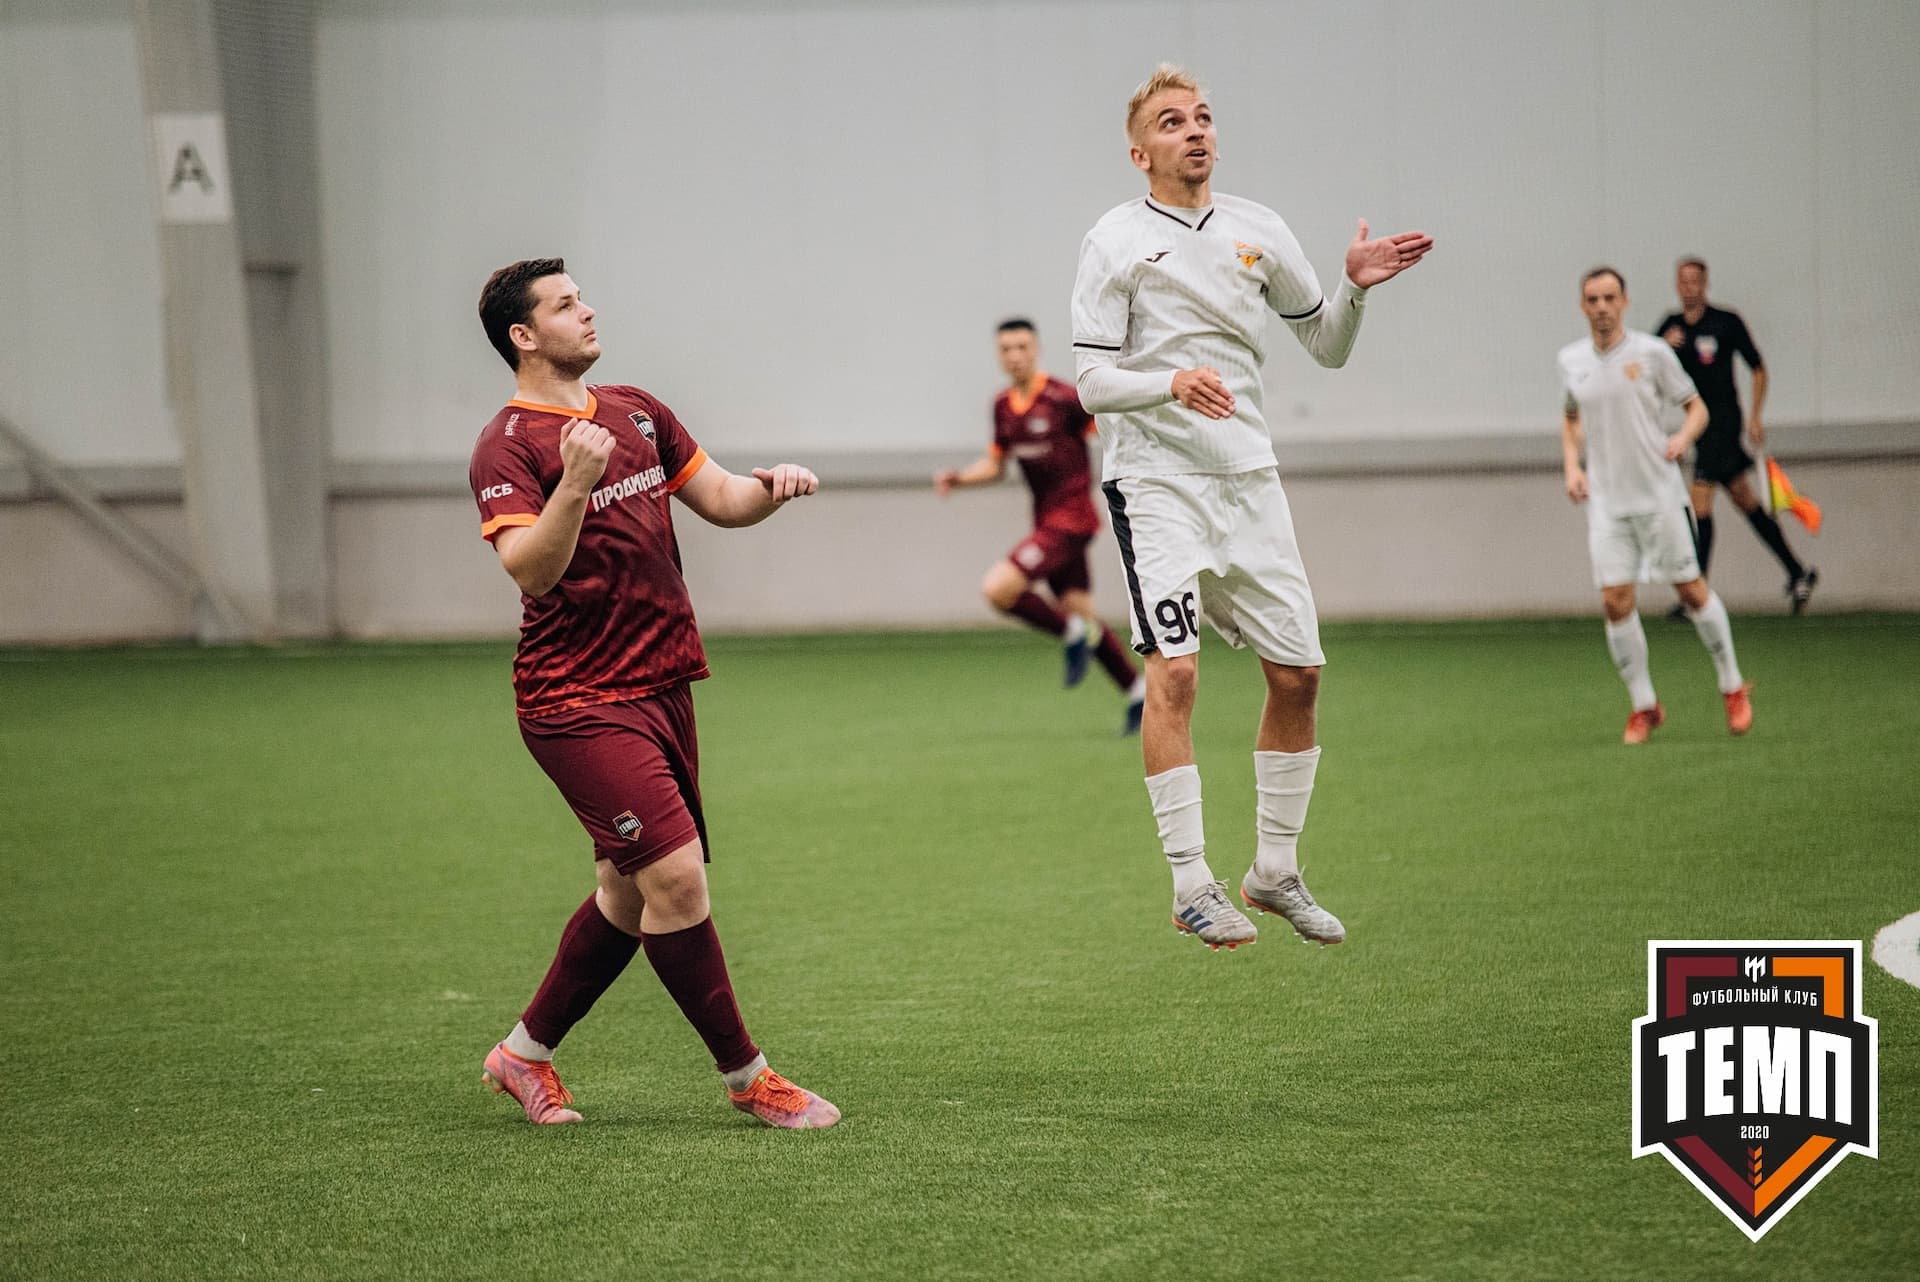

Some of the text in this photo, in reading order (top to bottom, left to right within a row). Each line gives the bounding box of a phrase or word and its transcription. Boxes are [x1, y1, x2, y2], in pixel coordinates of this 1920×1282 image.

[167, 141, 216, 196] A
[481, 483, 513, 502] ПСБ
[1155, 591, 1198, 645] 96
